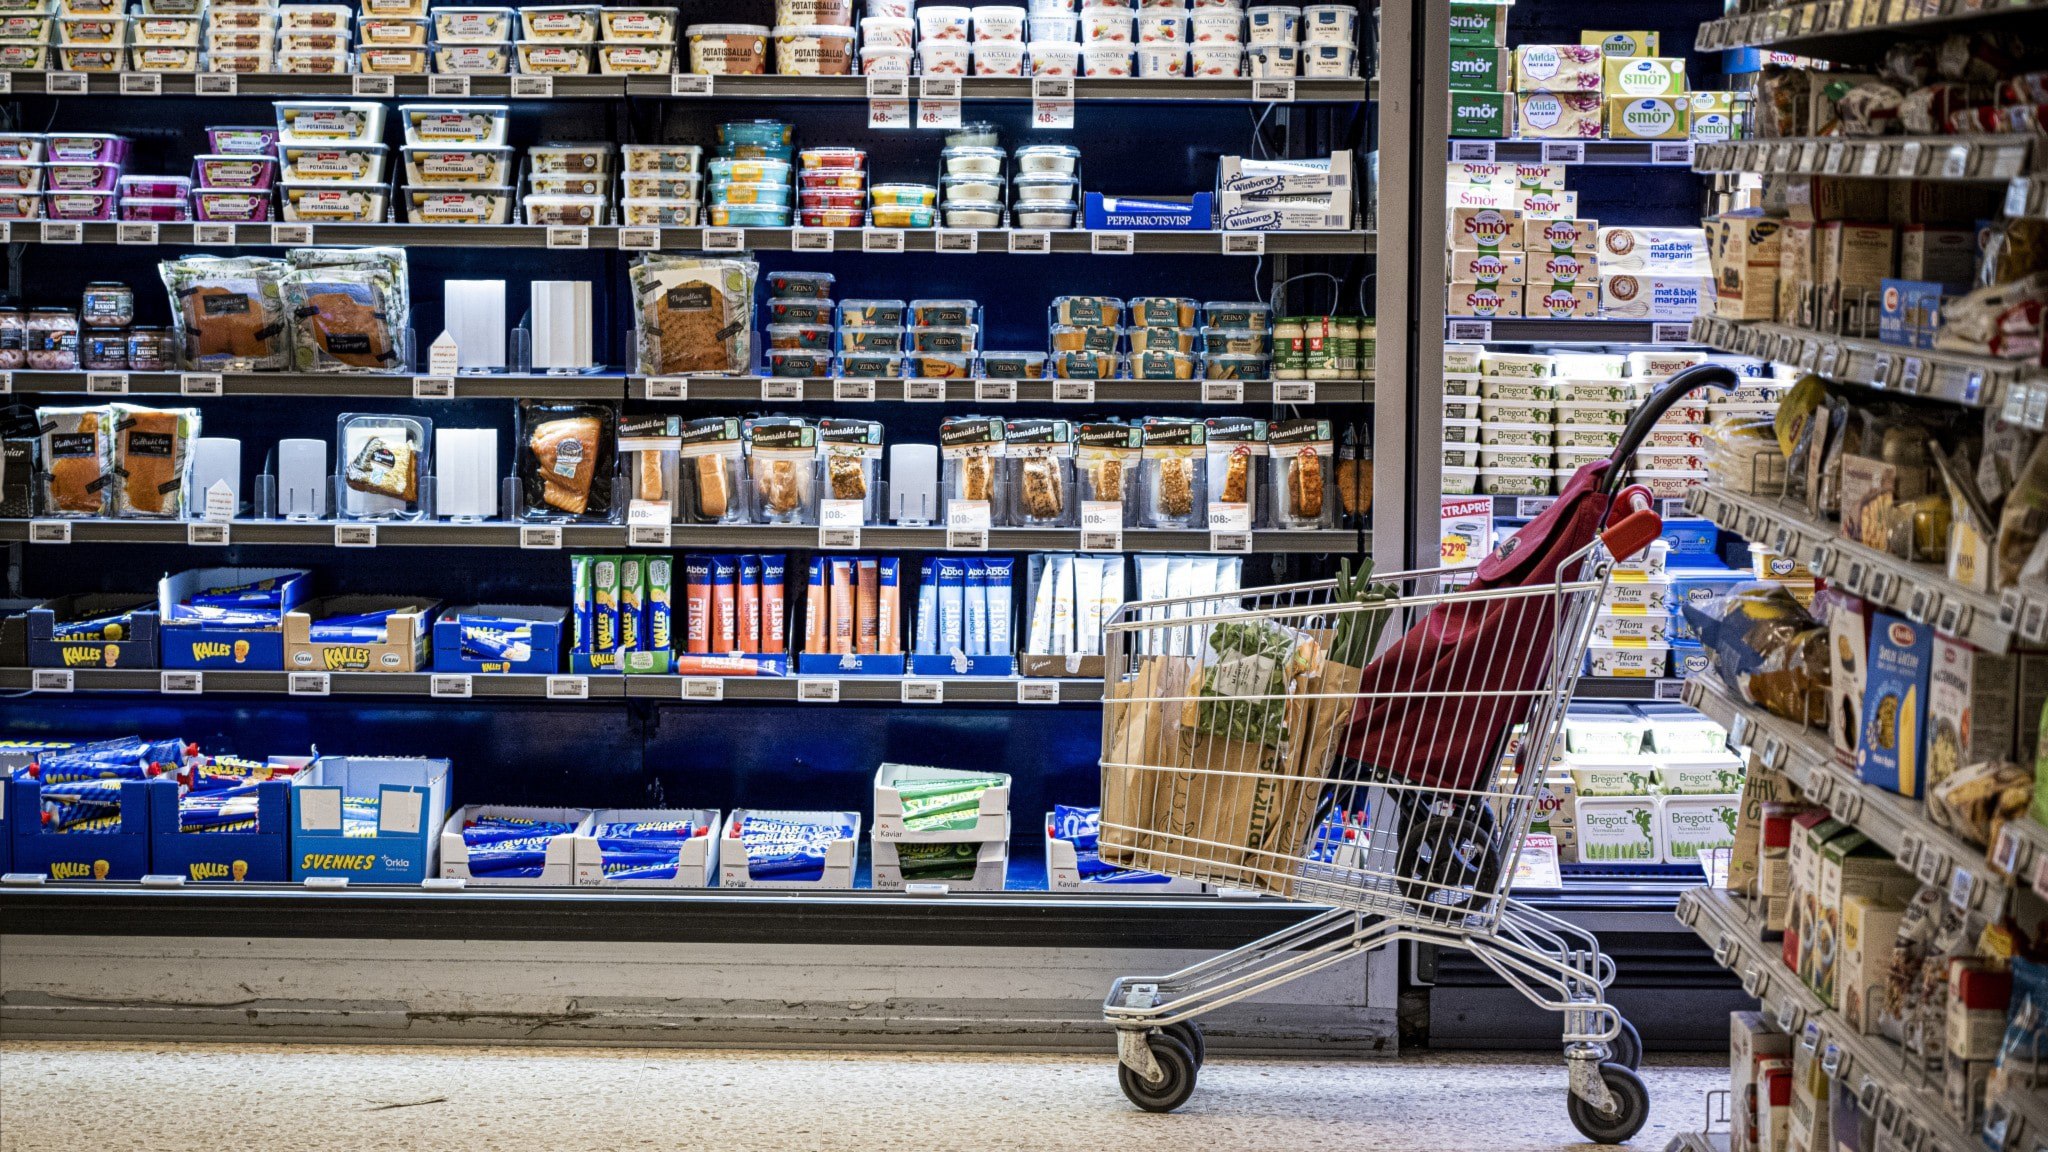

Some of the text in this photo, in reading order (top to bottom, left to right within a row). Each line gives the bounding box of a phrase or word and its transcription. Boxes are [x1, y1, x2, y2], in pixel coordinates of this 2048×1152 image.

[1449, 14, 1490, 28] smör
[703, 48, 752, 56] POTATISSALLAD
[1605, 42, 1634, 51] smör
[794, 49, 843, 58] POTATISSALLAD
[1528, 53, 1556, 62] Milda
[1451, 58, 1492, 73] smör
[1624, 70, 1667, 85] smör
[1458, 104, 1498, 118] smör
[1530, 102, 1556, 110] Milda
[1628, 108, 1671, 124] smör
[1697, 122, 1731, 134] smör
[1464, 164, 1502, 175] Smör
[1516, 164, 1550, 177] Smör
[1232, 175, 1275, 192] Winborgs
[1460, 192, 1498, 206] Smör
[1524, 198, 1560, 212] Smör
[1106, 216, 1192, 226] PEPPARROTSVISP
[1230, 212, 1272, 228] Winborgs
[1464, 217, 1514, 235] Smör
[1544, 227, 1582, 240] Smör
[1650, 252, 1693, 260] margarin
[1470, 260, 1508, 274] Smör
[1546, 260, 1584, 274] Smör
[1654, 288, 1697, 296] mat & bak
[1466, 294, 1504, 308] Smör
[1542, 295, 1580, 308] Smör
[1654, 296, 1697, 304] margarin
[941, 312, 962, 320] ZEINA
[1498, 362, 1528, 374] Bregott
[1650, 360, 1681, 372] Bregott
[1498, 385, 1528, 396] Bregott
[1574, 387, 1604, 398] Bregott
[1498, 408, 1528, 420] Bregott
[1574, 410, 1604, 421] Bregott
[618, 420, 666, 432] Varmrökt lax
[680, 424, 724, 438] Varmrökt lax
[820, 426, 868, 436] Varmrökt lax
[1206, 424, 1252, 436] Varmrökt lax
[752, 430, 800, 443] Varmrökt lax
[942, 426, 988, 440] Varmrökt lax
[1006, 426, 1052, 440] Varmrökt lax
[1082, 431, 1128, 442] Varmrökt lax
[1144, 428, 1190, 440] Varmrökt lax
[1270, 428, 1302, 440] Varmrökt
[1498, 431, 1527, 443] Bregott
[1574, 432, 1604, 443] Bregott
[1654, 432, 1684, 444] Bregott
[1498, 454, 1527, 466] Bregott
[1654, 456, 1683, 466] Bregott
[1498, 476, 1528, 488] Bregott
[1652, 478, 1682, 490] Bregott
[1441, 502, 1490, 517] XTRAPRIS
[686, 566, 708, 574] Abba
[716, 566, 734, 574] Abba
[766, 566, 784, 574] Abba
[940, 567, 964, 576] Abba
[986, 568, 1010, 576] Abba
[1772, 562, 1793, 570] Becel
[1614, 586, 1642, 597] Flora
[1690, 592, 1710, 600] Becel
[688, 598, 702, 640] PASTEJ
[722, 598, 734, 640] PASTEJ
[772, 598, 784, 640] PASTEJ
[946, 600, 960, 642] PASTEJ
[991, 600, 1006, 642] PASTEJ
[1616, 618, 1643, 630] Flora
[598, 612, 614, 650] KALLES
[623, 612, 637, 648] KALLES
[654, 610, 670, 648] KALLES
[62, 644, 101, 666] KALLES
[192, 642, 230, 662] KALLES
[1616, 652, 1643, 663] Flora
[322, 647, 370, 670] KALLES
[590, 654, 616, 668] KALLE
[1686, 659, 1706, 667] Becel
[482, 662, 501, 672] KALLES
[198, 765, 247, 777] KALLES
[1591, 774, 1624, 786] Bregott
[1679, 773, 1712, 785] Bregott
[1586, 814, 1628, 828] Bregott
[1672, 812, 1714, 826] Bregott
[880, 830, 902, 838] Kaviar
[301, 854, 376, 870] SVENNES
[386, 858, 410, 868] Orkla
[51, 862, 90, 879] KALLES
[190, 862, 229, 880] KALLES
[580, 878, 602, 886] Kaviar
[878, 879, 900, 888] Kaviar
[1058, 880, 1080, 888] Kaviar
